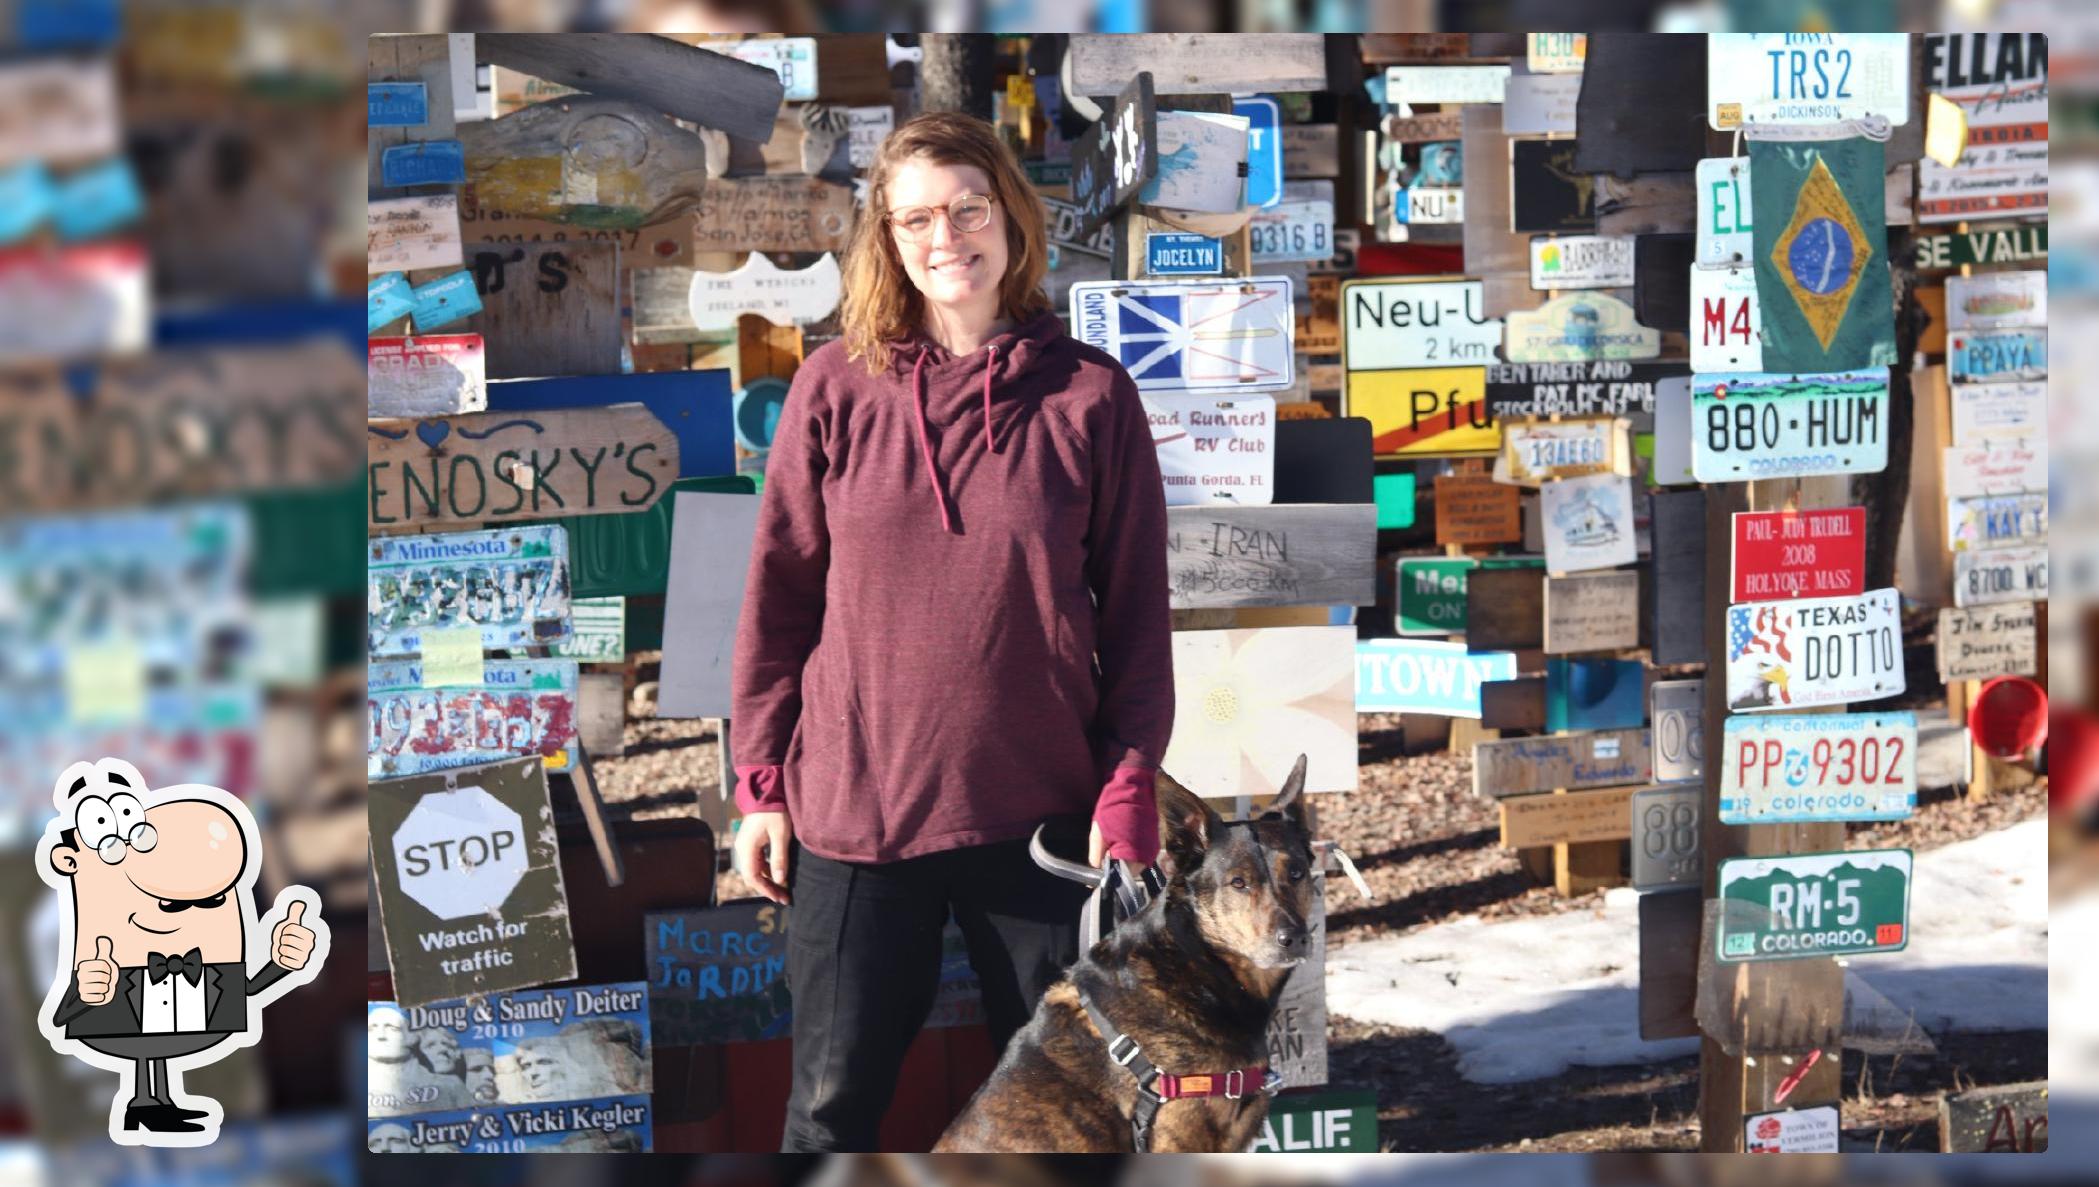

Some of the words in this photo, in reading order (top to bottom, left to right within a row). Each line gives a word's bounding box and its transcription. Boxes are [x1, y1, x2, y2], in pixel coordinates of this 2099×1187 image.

[1767, 49, 1852, 99] TRS2
[1778, 104, 1841, 119] DICKINSON
[1411, 196, 1443, 218] NU
[1153, 248, 1214, 266] JOCELYN
[1425, 337, 1438, 360] 2
[1450, 337, 1487, 359] km
[1190, 410, 1265, 426] Runners
[1194, 438, 1220, 452] RV
[1228, 437, 1266, 452] Club
[1749, 454, 1837, 471] COLORADO
[370, 442, 657, 523] ENOSKY'S
[1250, 474, 1264, 486] FL
[1781, 517, 1805, 539] JUDY
[1810, 515, 1852, 538] TRUDELL
[399, 539, 506, 561] Minnesota
[1209, 522, 1289, 562] IRAN
[1781, 545, 1816, 566] 2008
[1814, 569, 1851, 590] MASS
[1797, 603, 1867, 628] TEXAS
[1805, 626, 1894, 682] DOTTO
[1783, 720, 1865, 732] centennial
[1812, 737, 1905, 786] 9302
[1771, 792, 1865, 810] colorado
[404, 830, 515, 877] STOP
[418, 925, 493, 952] Watch
[497, 920, 528, 940] for
[1762, 928, 1867, 952] COLORADO
[440, 950, 513, 976] traffic
[410, 1004, 467, 1031] Doug
[473, 1003, 493, 1023] &
[500, 996, 567, 1025] Sandy
[576, 988, 642, 1016] Deiter
[472, 1023, 525, 1040] 2010
[407, 1086, 439, 1103] SD
[411, 1119, 473, 1147] Jerry
[480, 1114, 503, 1137] &
[508, 1108, 565, 1135] Vicki
[571, 1103, 645, 1133] Kegler
